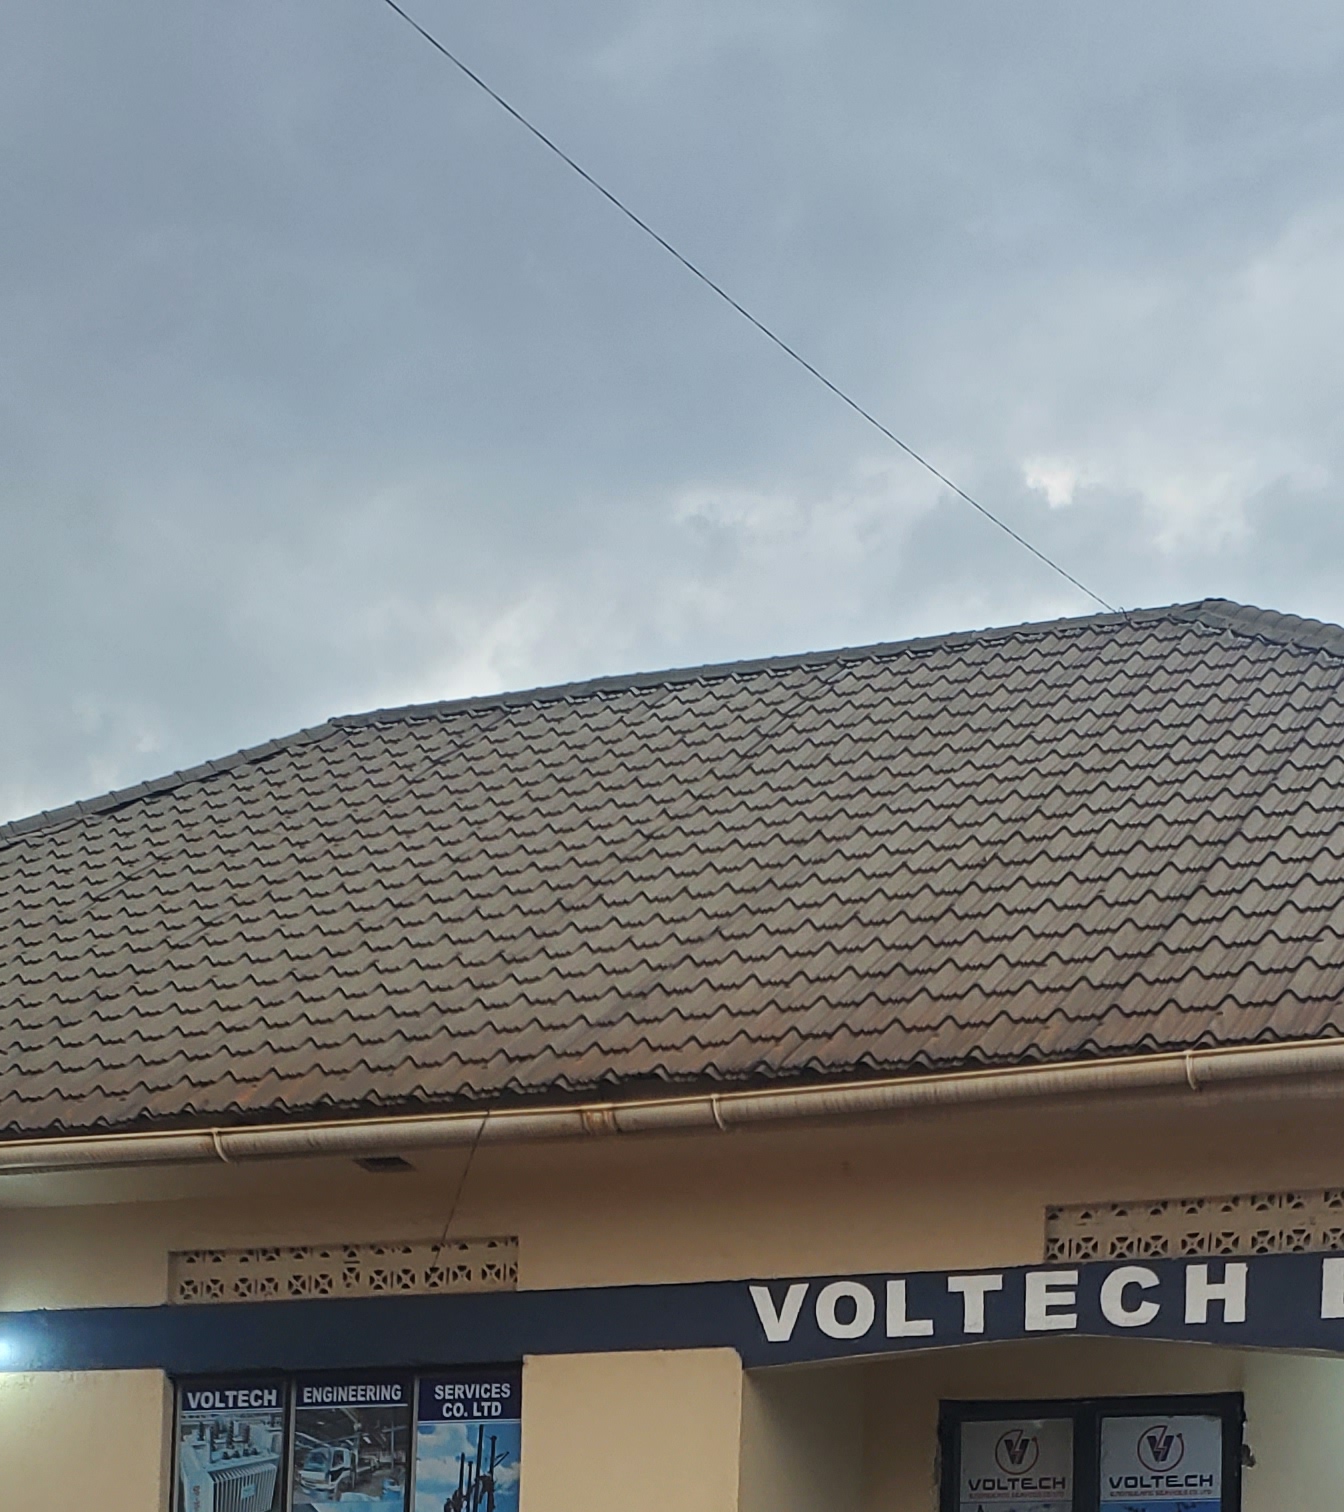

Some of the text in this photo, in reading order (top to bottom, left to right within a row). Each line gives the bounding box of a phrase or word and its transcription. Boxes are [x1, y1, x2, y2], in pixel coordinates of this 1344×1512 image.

[748, 1262, 1248, 1343] VOLTECH
[187, 1383, 511, 1409] VOLTECH ENGINEERING SERVICES
[442, 1401, 501, 1417] CO. LTD
[968, 1477, 1065, 1490] VOLTECH
[1109, 1474, 1213, 1488] VOLTECH
